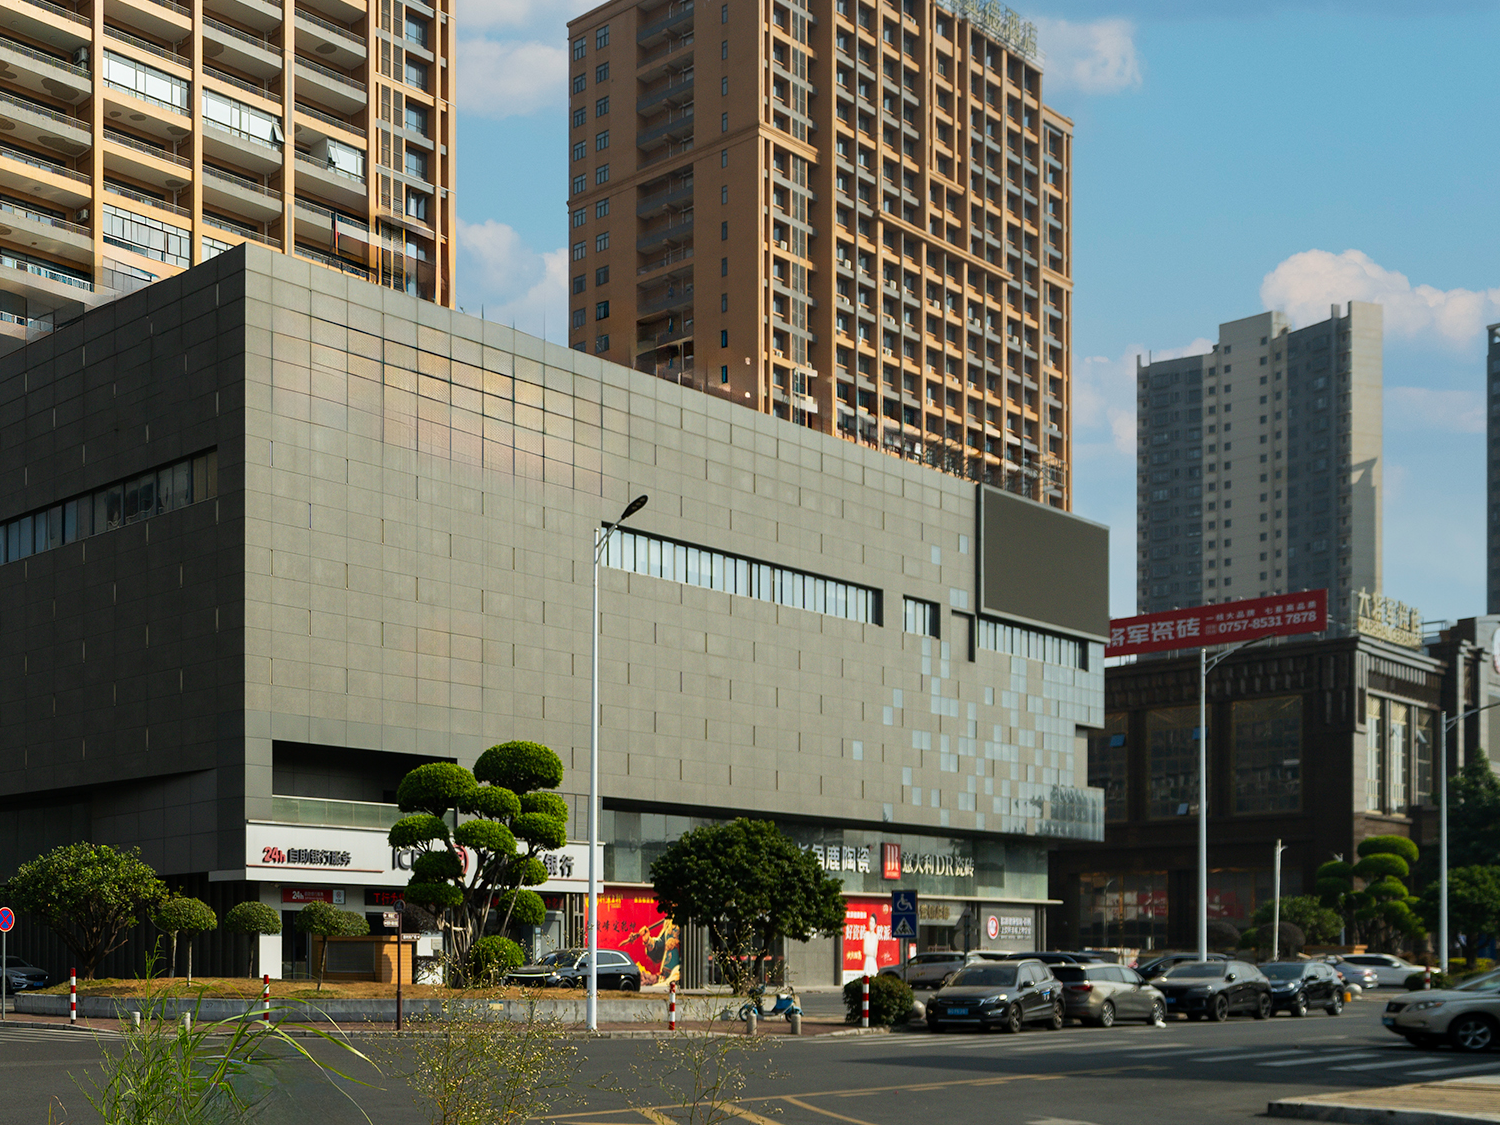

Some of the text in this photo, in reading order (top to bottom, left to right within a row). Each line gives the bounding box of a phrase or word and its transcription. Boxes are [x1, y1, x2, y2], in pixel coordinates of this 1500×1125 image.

[1218, 615, 1283, 634] 0757-8531
[1285, 610, 1318, 626] 7878
[262, 846, 352, 867] 24h 自助银行服务
